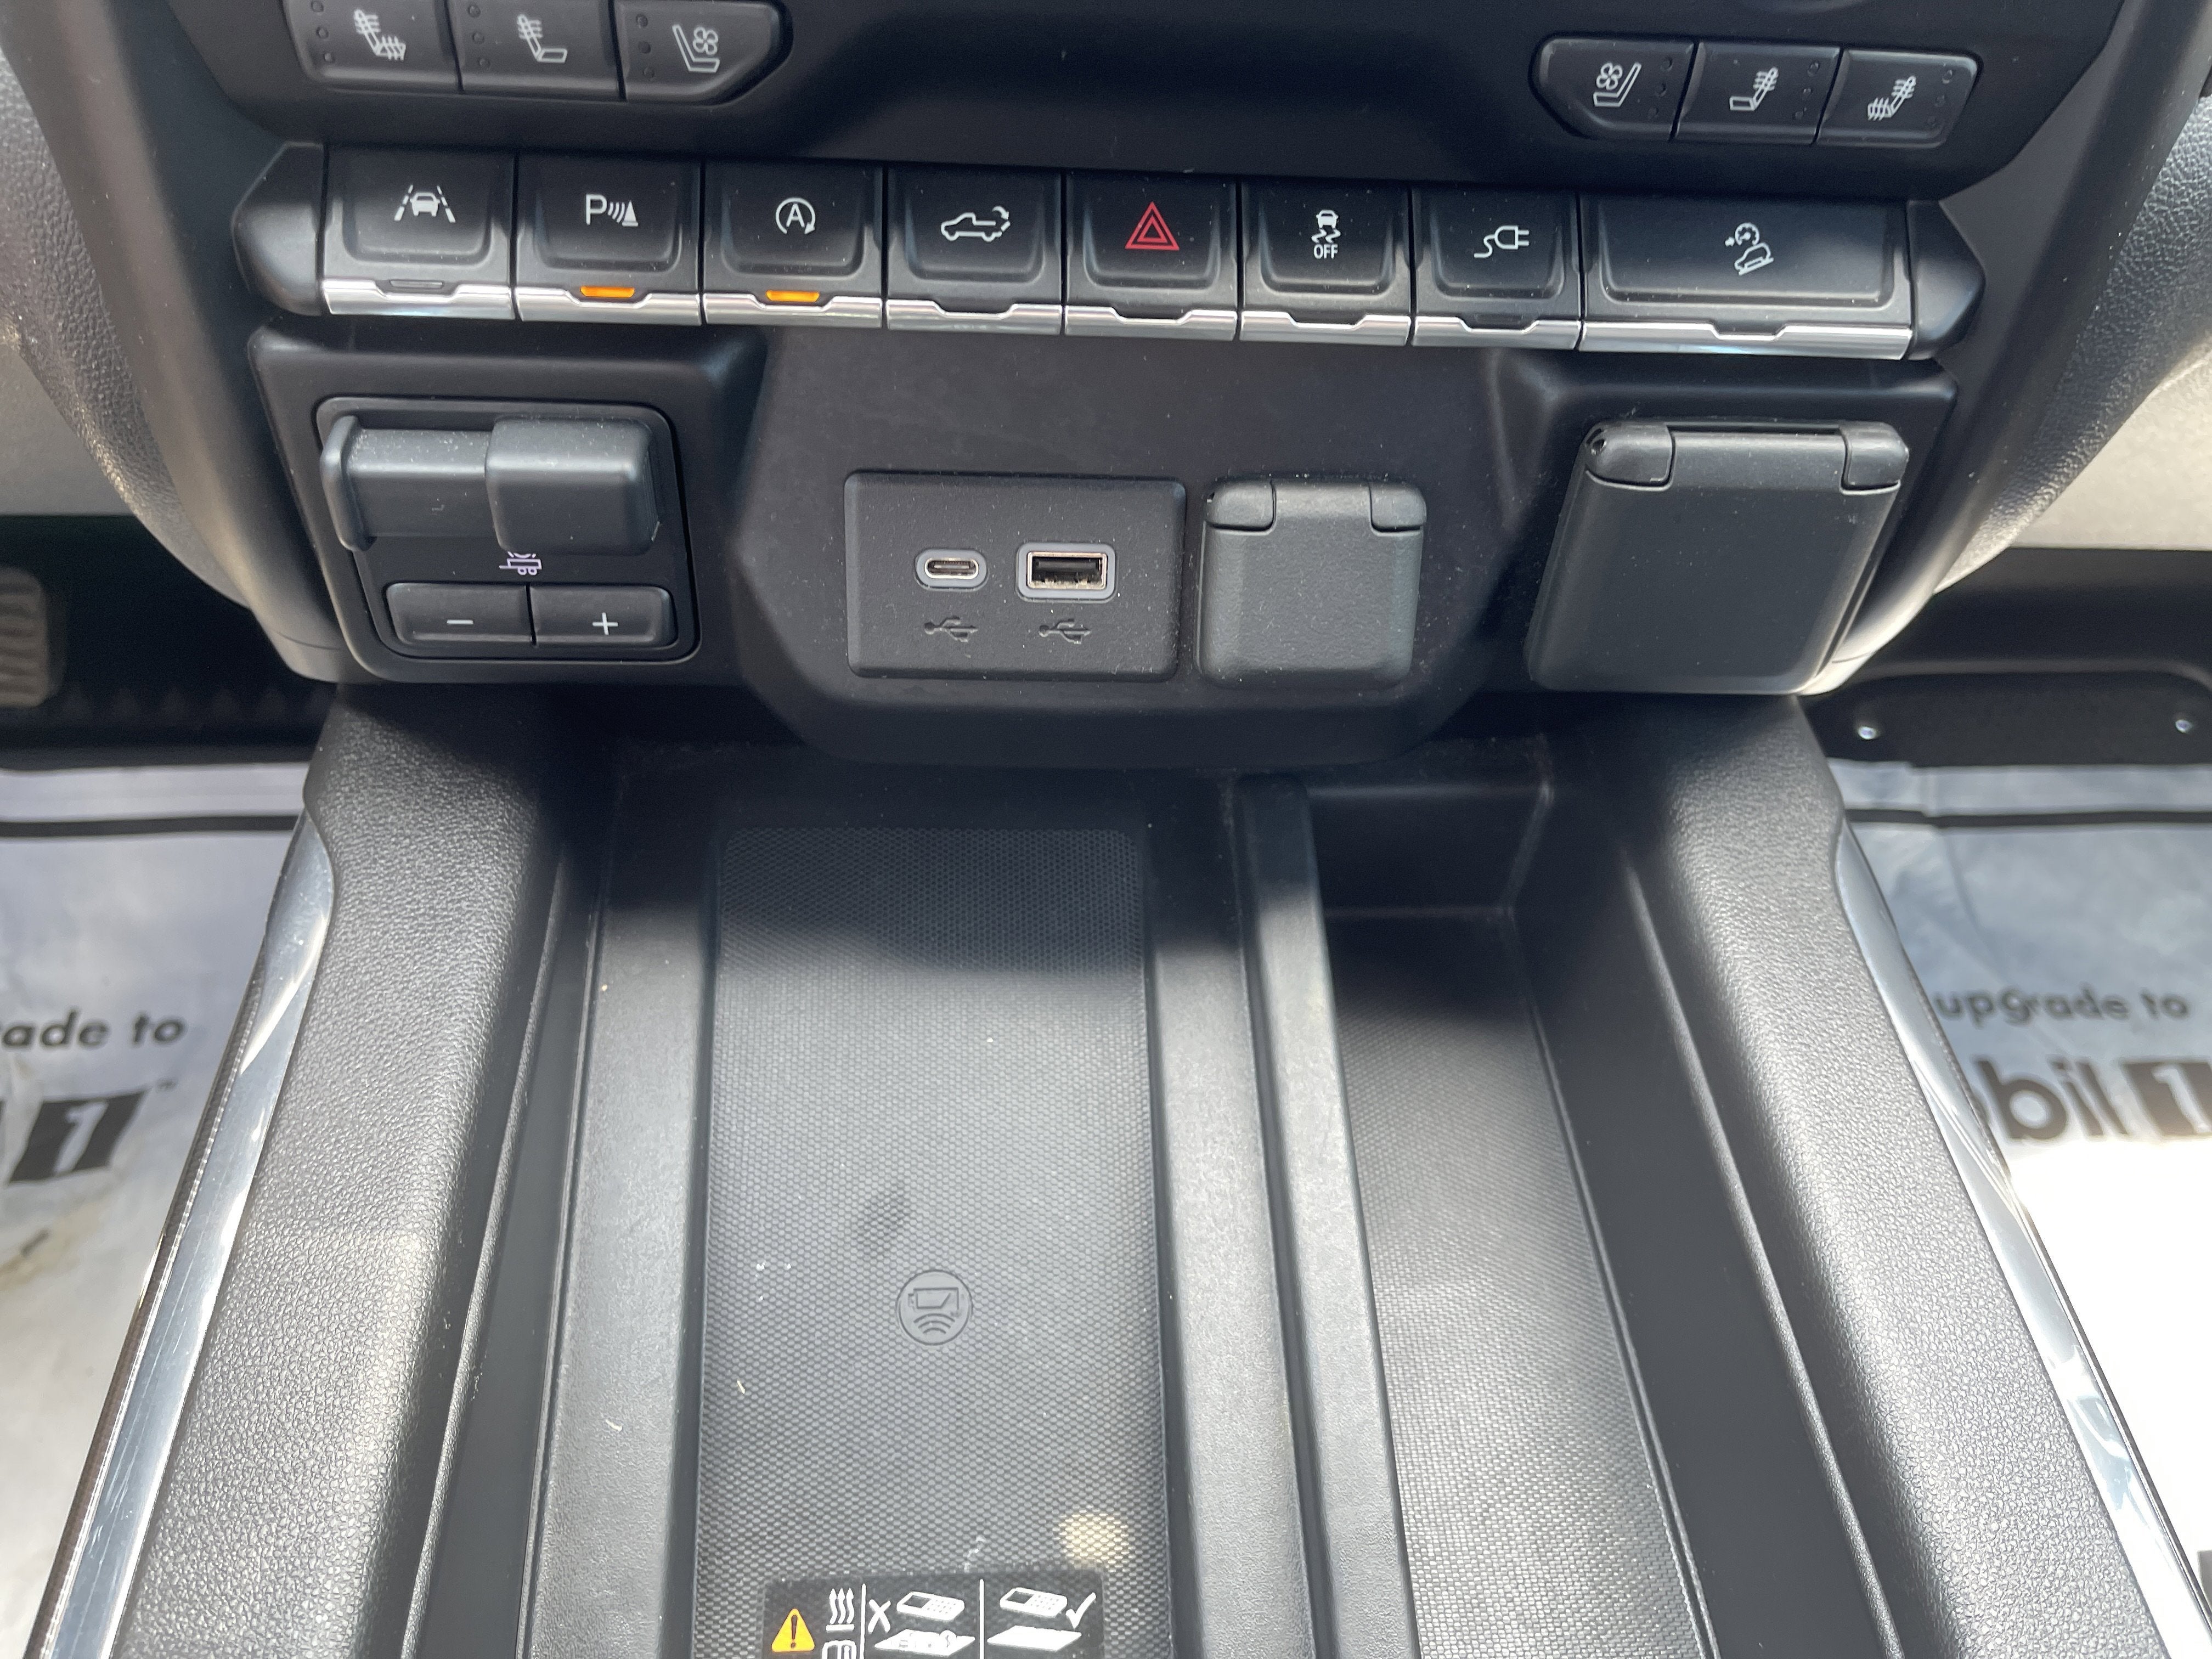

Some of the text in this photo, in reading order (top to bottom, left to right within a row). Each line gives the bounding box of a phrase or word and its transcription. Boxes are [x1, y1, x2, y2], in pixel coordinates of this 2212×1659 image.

[1313, 243, 1339, 260] OFF
[1933, 984, 2190, 1027] upgrade to
[0, 1008, 184, 1048] ade to
[1974, 1057, 2212, 1141] bil 1
